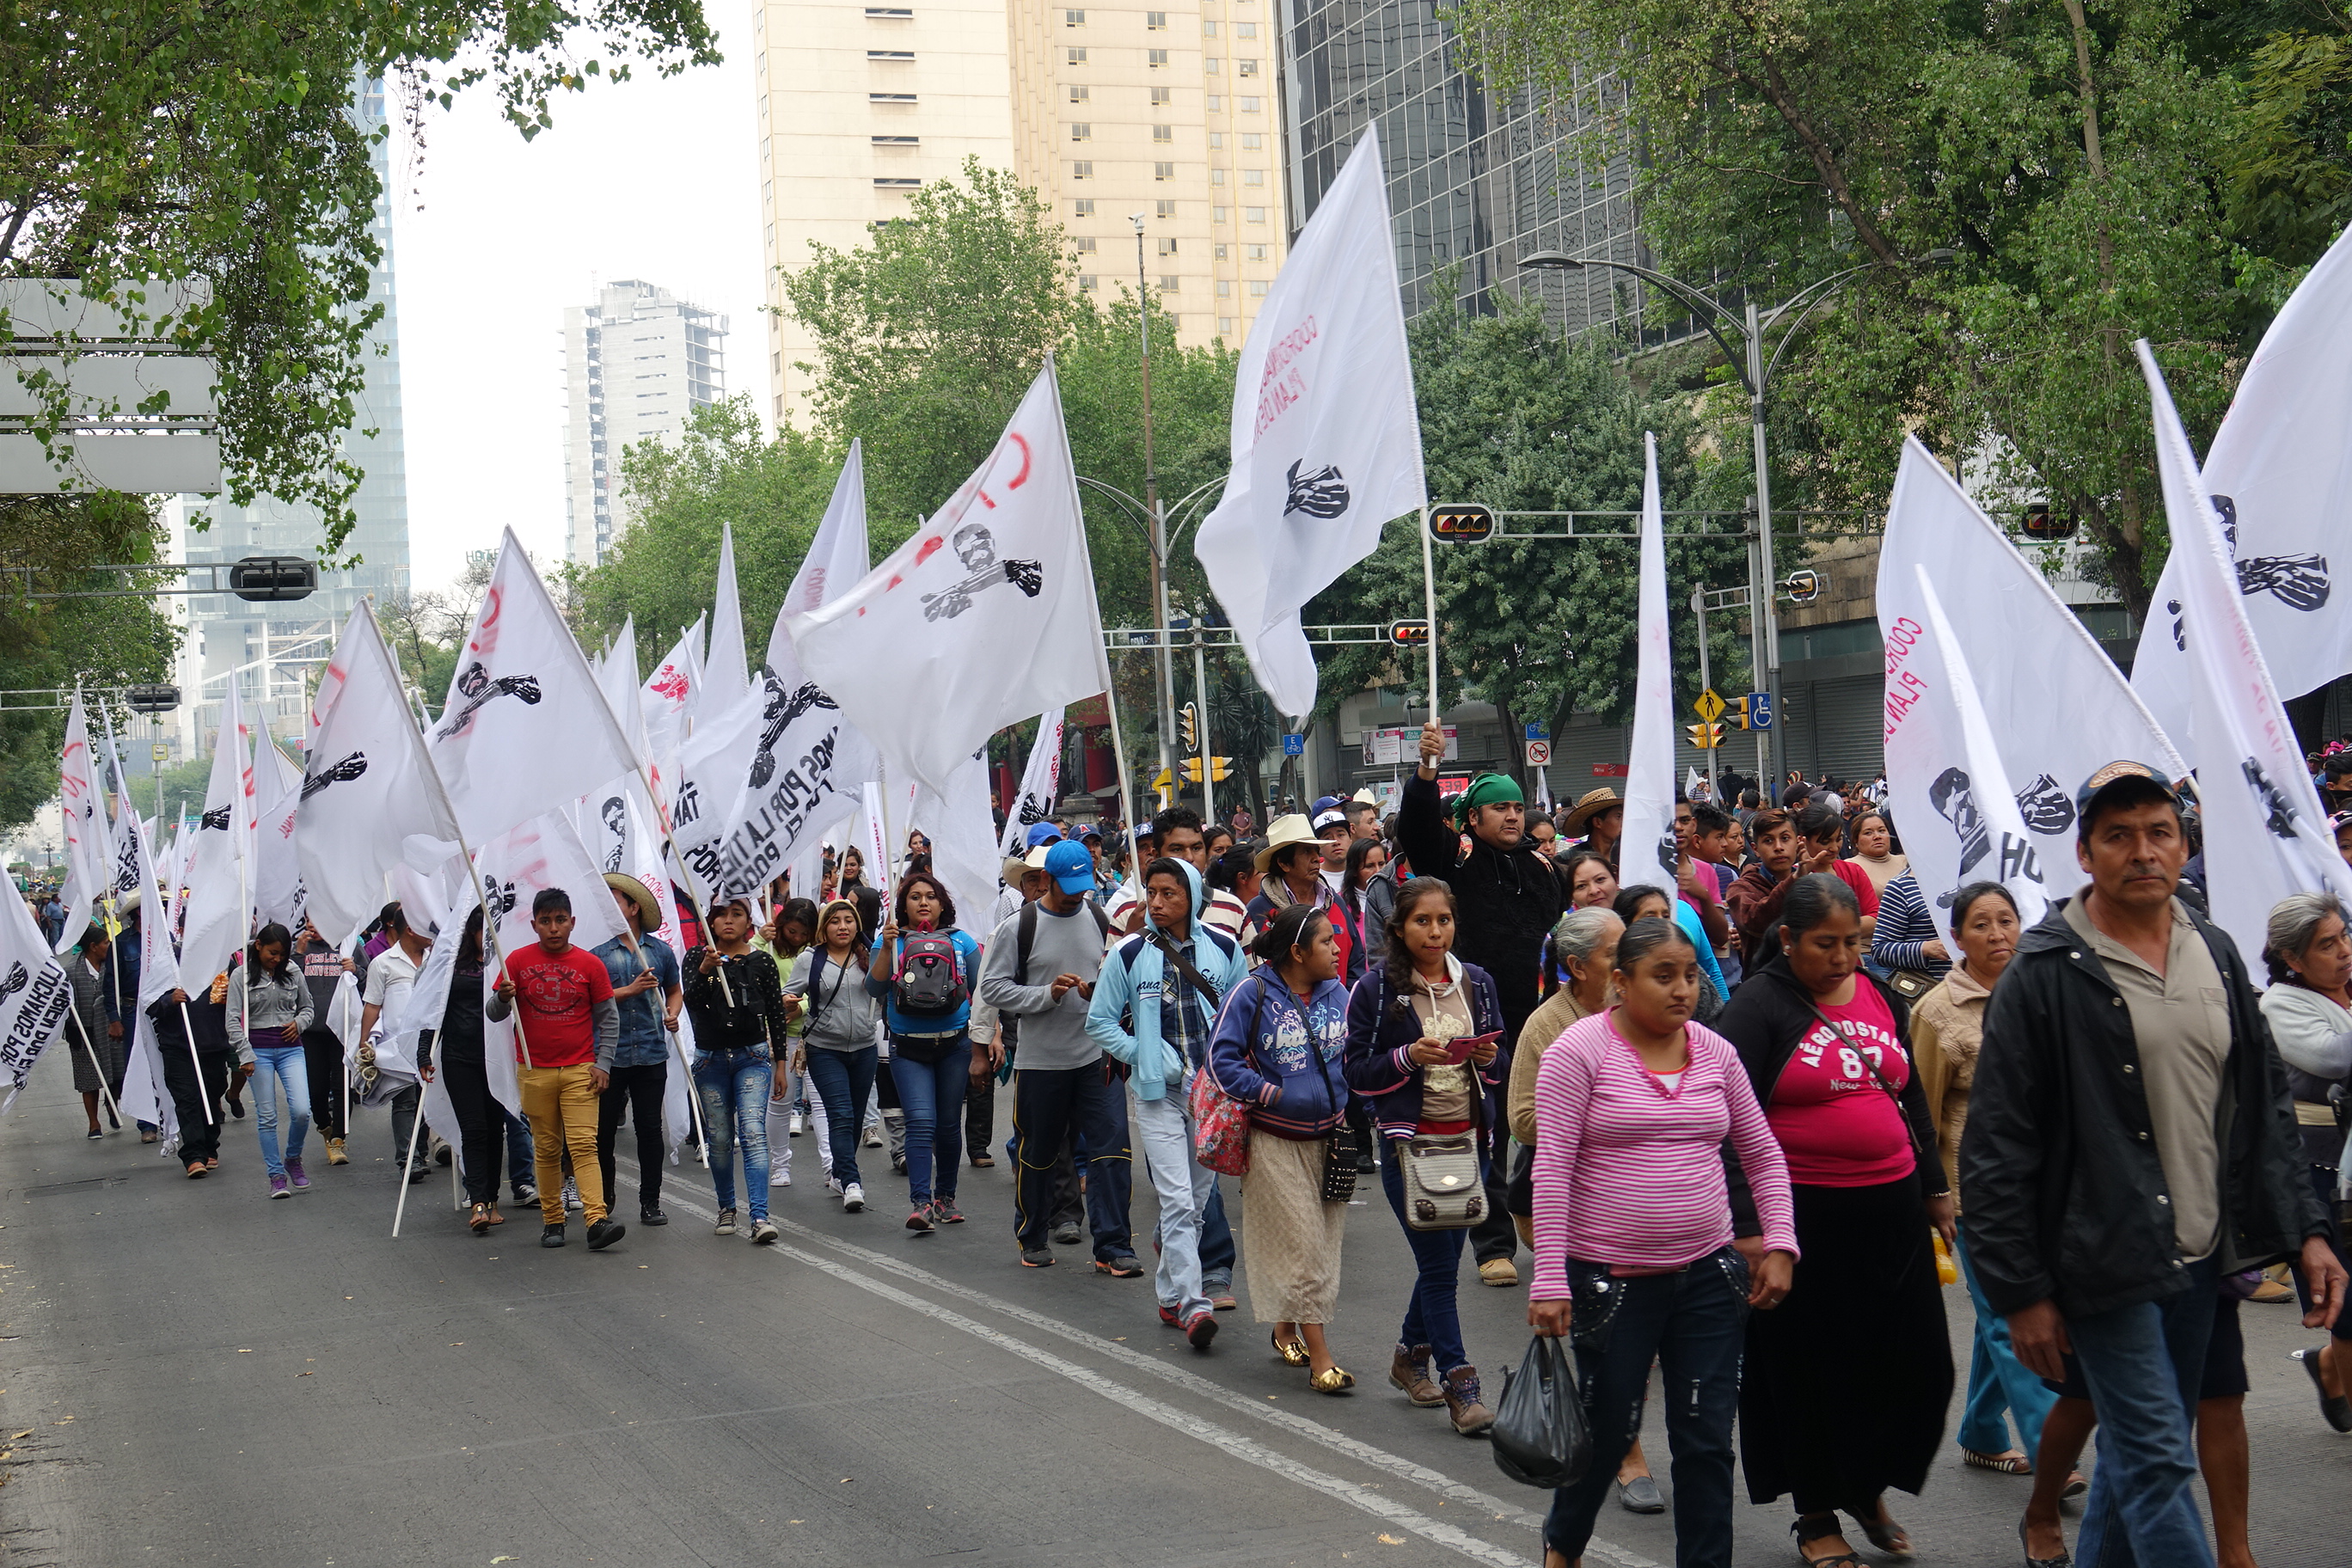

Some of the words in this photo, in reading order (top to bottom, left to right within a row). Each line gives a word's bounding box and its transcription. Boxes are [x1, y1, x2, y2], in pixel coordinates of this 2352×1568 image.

[1290, 736, 1295, 744] E
[1838, 1045, 1883, 1079] 87
[1830, 1079, 1861, 1091] New
